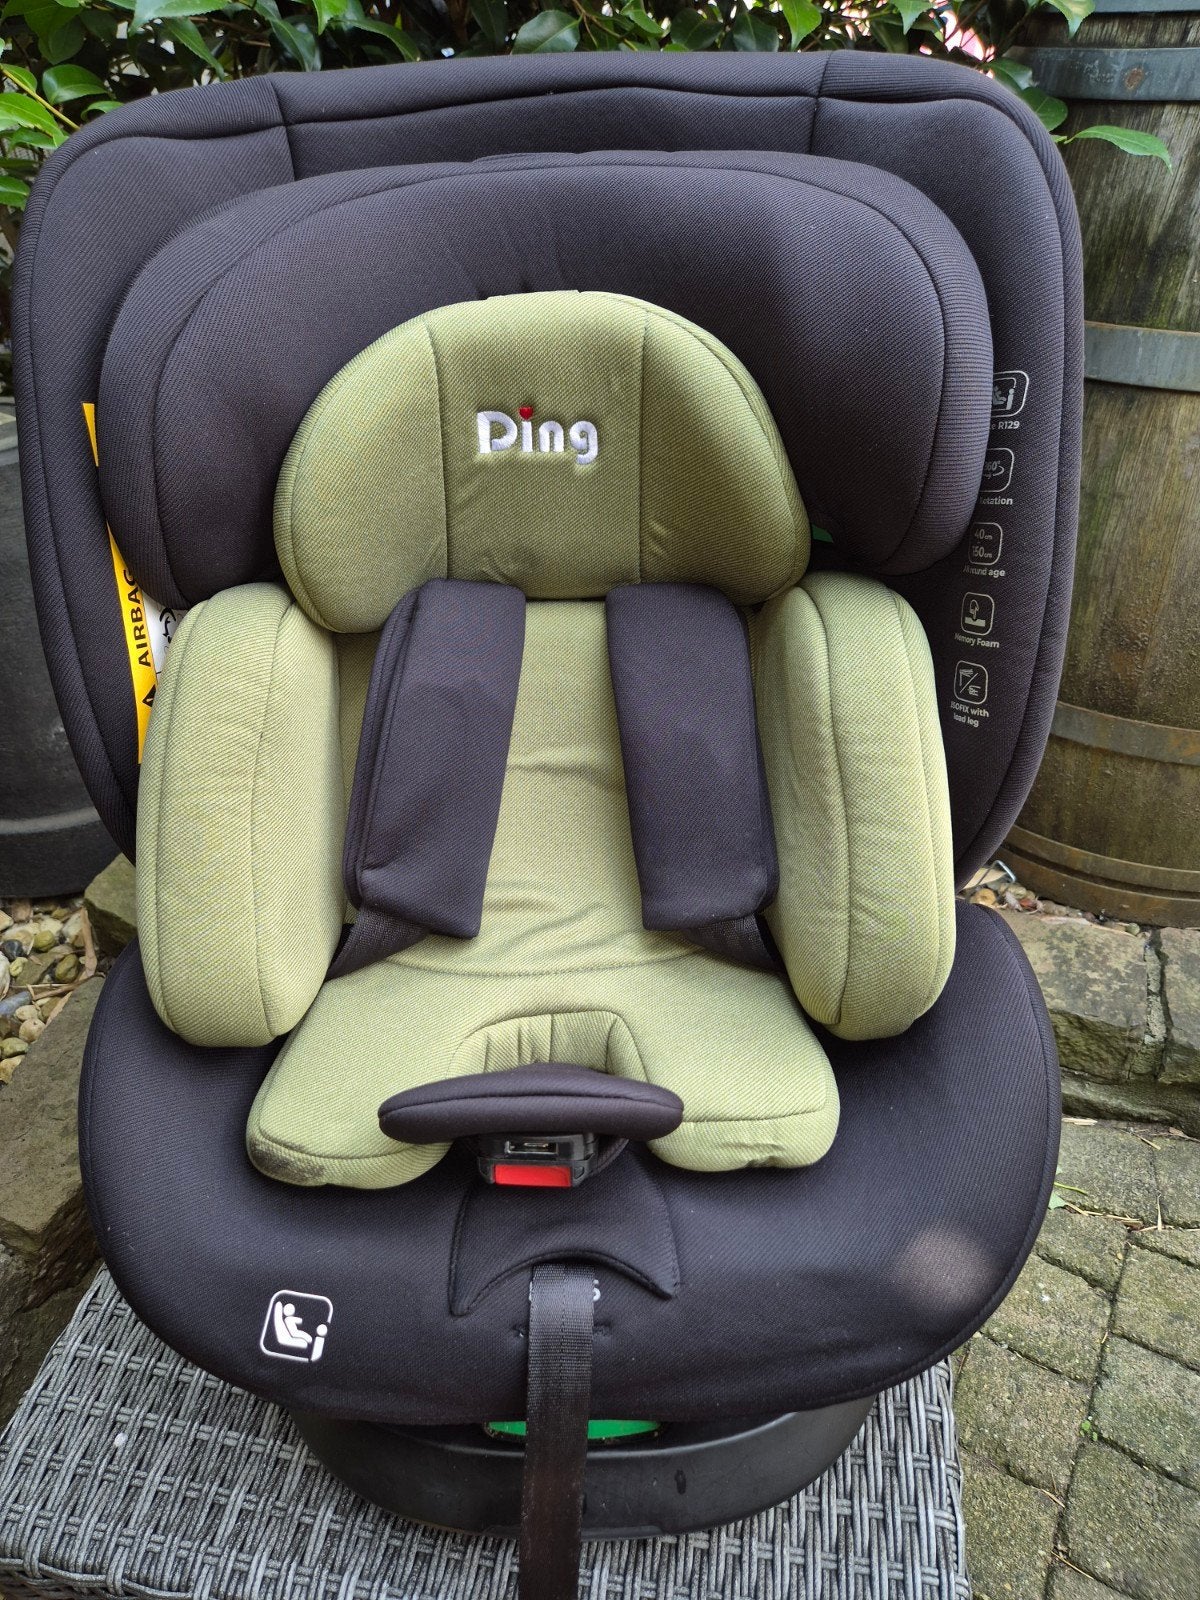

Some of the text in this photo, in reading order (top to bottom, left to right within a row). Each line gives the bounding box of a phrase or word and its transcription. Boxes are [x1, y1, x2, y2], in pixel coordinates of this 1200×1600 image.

[997, 420, 1020, 430] R129
[476, 405, 599, 465] Ding
[988, 569, 1006, 578] age
[954, 632, 1000, 648] Memory Foam
[950, 700, 989, 718] ISOFIX with
[966, 716, 979, 728] leg
